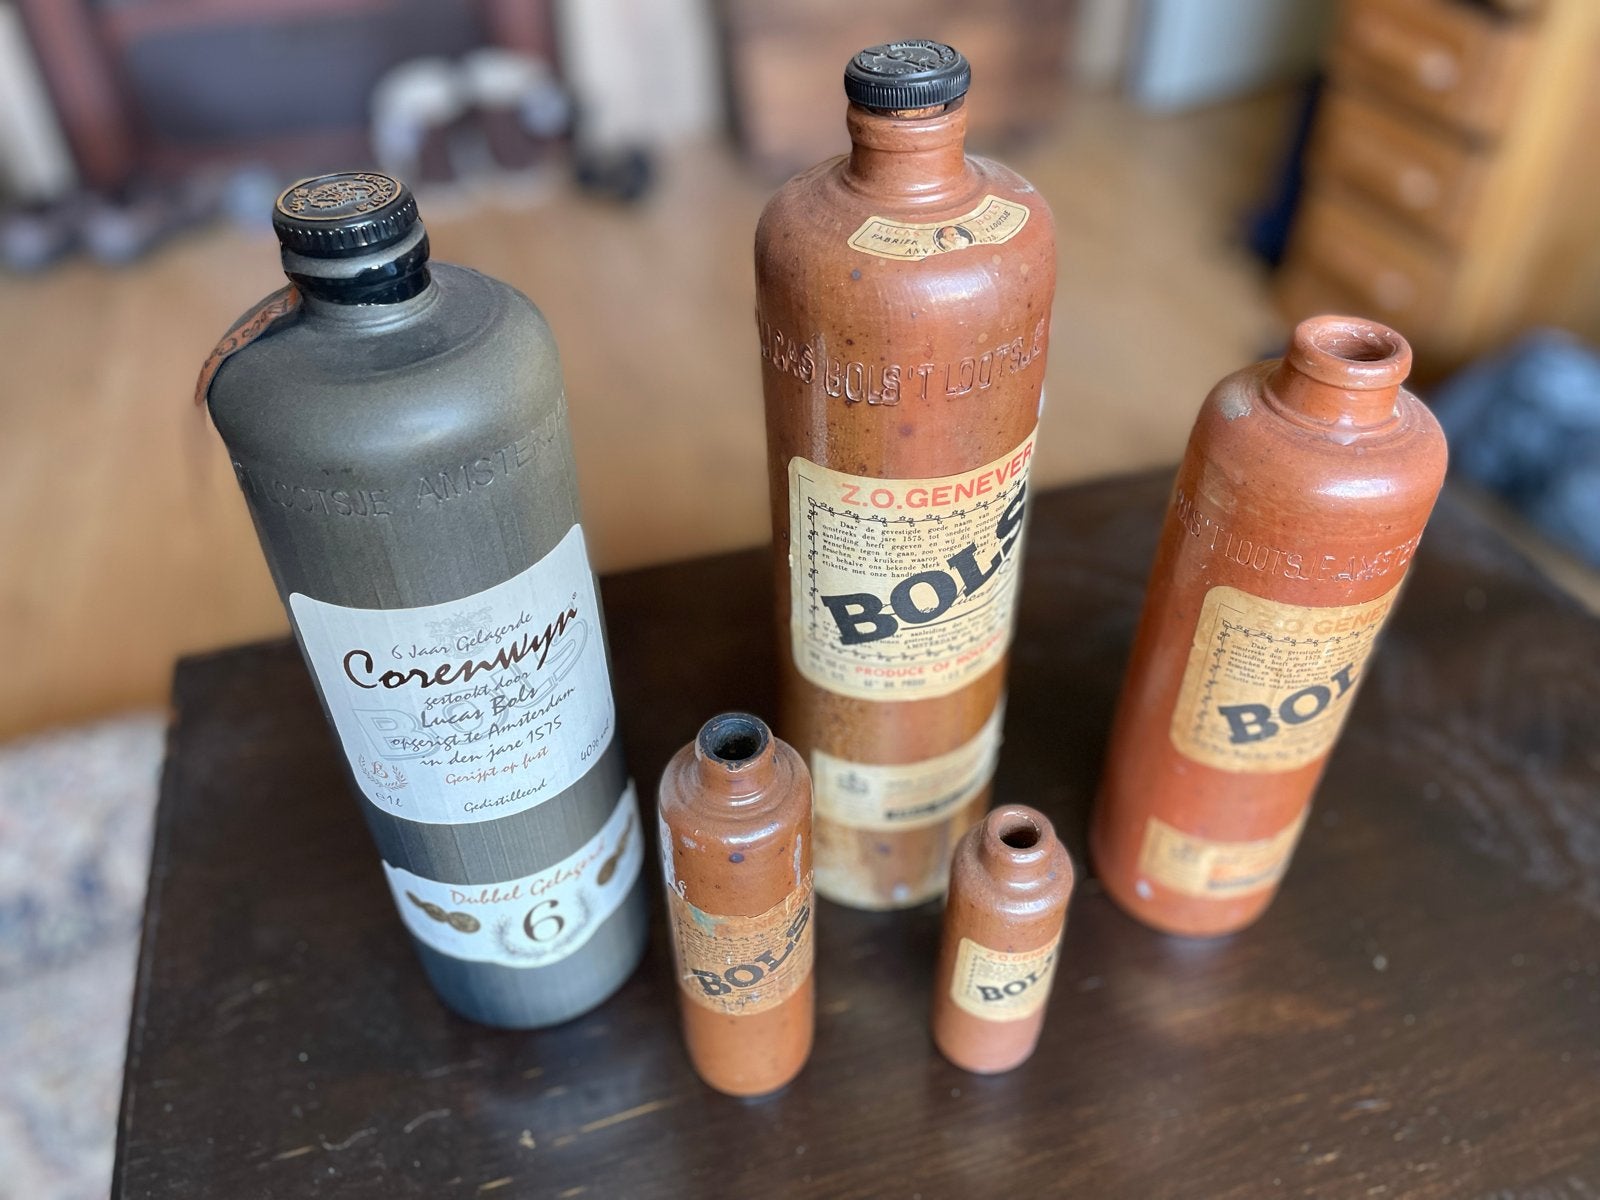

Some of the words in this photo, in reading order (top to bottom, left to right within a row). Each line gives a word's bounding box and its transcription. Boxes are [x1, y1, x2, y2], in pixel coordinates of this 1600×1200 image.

[871, 233, 919, 246] FABRIEK
[824, 356, 901, 406] BOLS
[866, 541, 885, 549] heeft
[881, 528, 921, 536] gevestigde
[928, 525, 948, 534] goede
[954, 519, 973, 528] naam
[820, 481, 1027, 646] BOLS
[836, 556, 863, 568] behalve
[886, 563, 917, 571] bekende
[874, 556, 903, 564] kruiken
[391, 644, 403, 660] 6
[407, 643, 450, 660] Jaar
[456, 610, 533, 652] Gelagerde
[855, 665, 925, 679] PRODUCE
[932, 662, 950, 674] OF
[420, 709, 484, 729] Lucas
[491, 686, 539, 716] Bols
[423, 683, 491, 710] gestookt
[493, 671, 531, 691] door
[1217, 662, 1355, 744] BOL
[488, 686, 576, 738] Amsterdam
[419, 754, 443, 767] in
[449, 749, 483, 766] den
[485, 738, 523, 764] jare
[525, 715, 563, 744] 1575
[501, 759, 520, 775] op
[463, 778, 548, 814] Gedistilleerd
[449, 885, 522, 906] Dubbel
[523, 899, 565, 943] 6
[691, 905, 811, 996] BOLS
